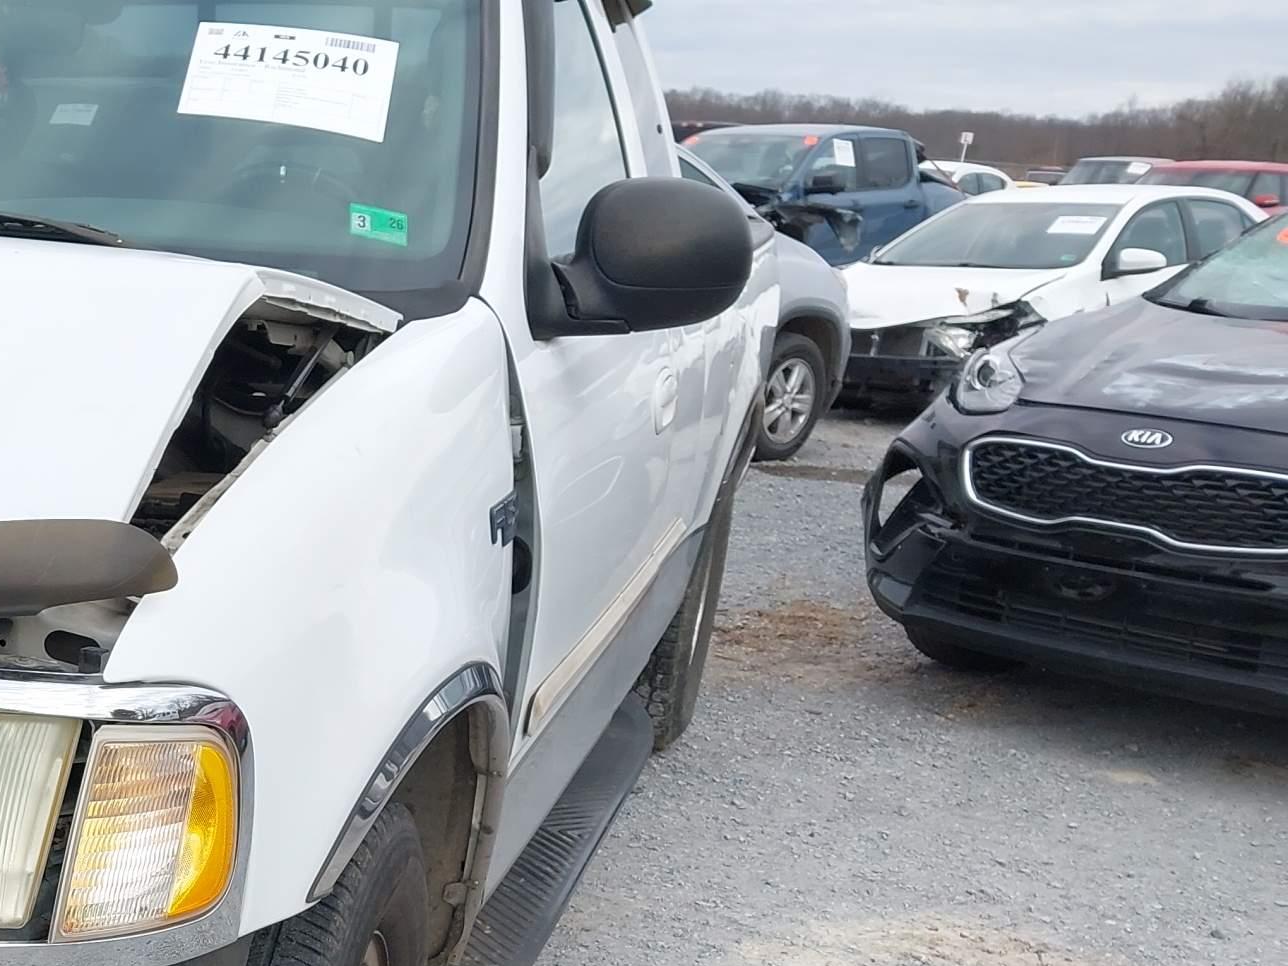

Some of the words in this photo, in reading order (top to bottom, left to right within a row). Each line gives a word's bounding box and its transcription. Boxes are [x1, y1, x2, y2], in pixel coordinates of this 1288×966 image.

[213, 43, 369, 76] 44145040
[357, 215, 367, 229] 3
[389, 217, 404, 231] 26
[1128, 430, 1162, 445] KIA
